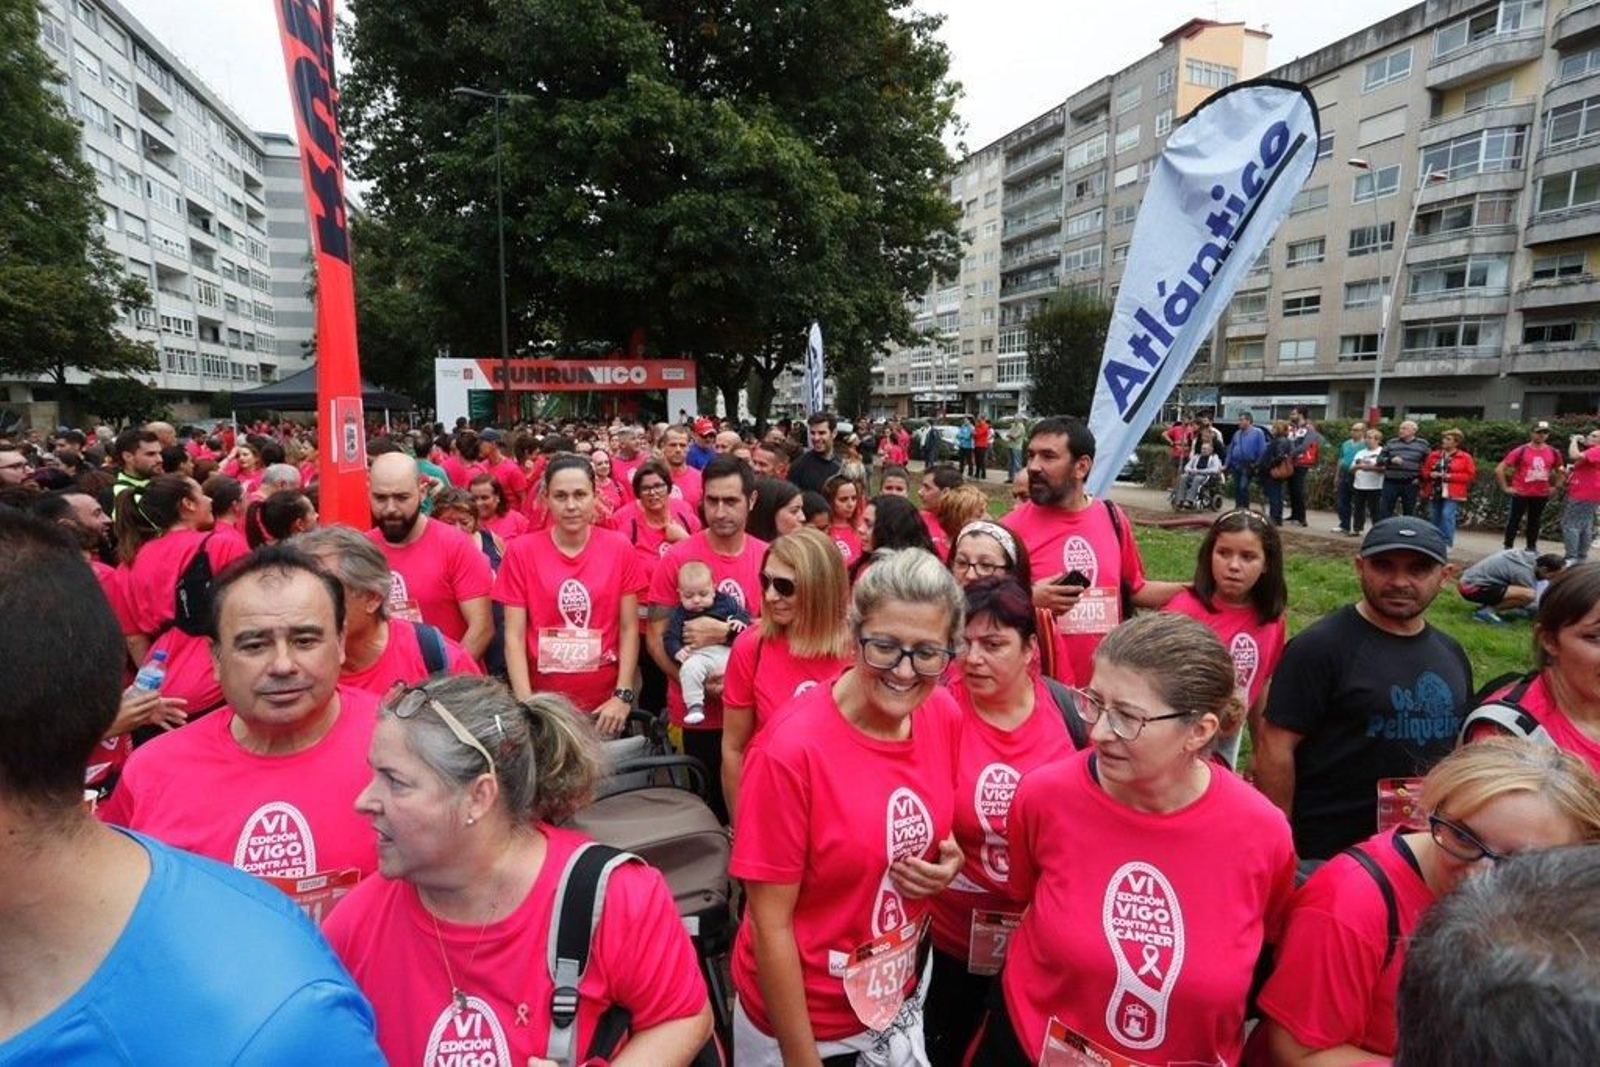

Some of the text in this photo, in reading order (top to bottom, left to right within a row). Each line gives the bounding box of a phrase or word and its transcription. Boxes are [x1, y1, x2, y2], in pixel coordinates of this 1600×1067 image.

[1103, 120, 1290, 415] Atlántico
[992, 771, 1009, 784] VI
[896, 799, 914, 816] VI
[261, 814, 288, 833] VI
[894, 822, 926, 842] VIGO
[250, 832, 298, 845] EDICIÓN
[248, 842, 302, 861] VIGO
[245, 857, 306, 872] CONTRA EL
[1128, 874, 1154, 895] VI
[1117, 892, 1165, 907] EDICIÓN
[1115, 901, 1170, 923] VIGO
[1113, 917, 1174, 935] CONTRA EL
[1116, 928, 1173, 947] CÁNCER
[454, 1013, 482, 1037] VI
[440, 1037, 492, 1053] EDICIÓN
[437, 1051, 497, 1067] VIGO
